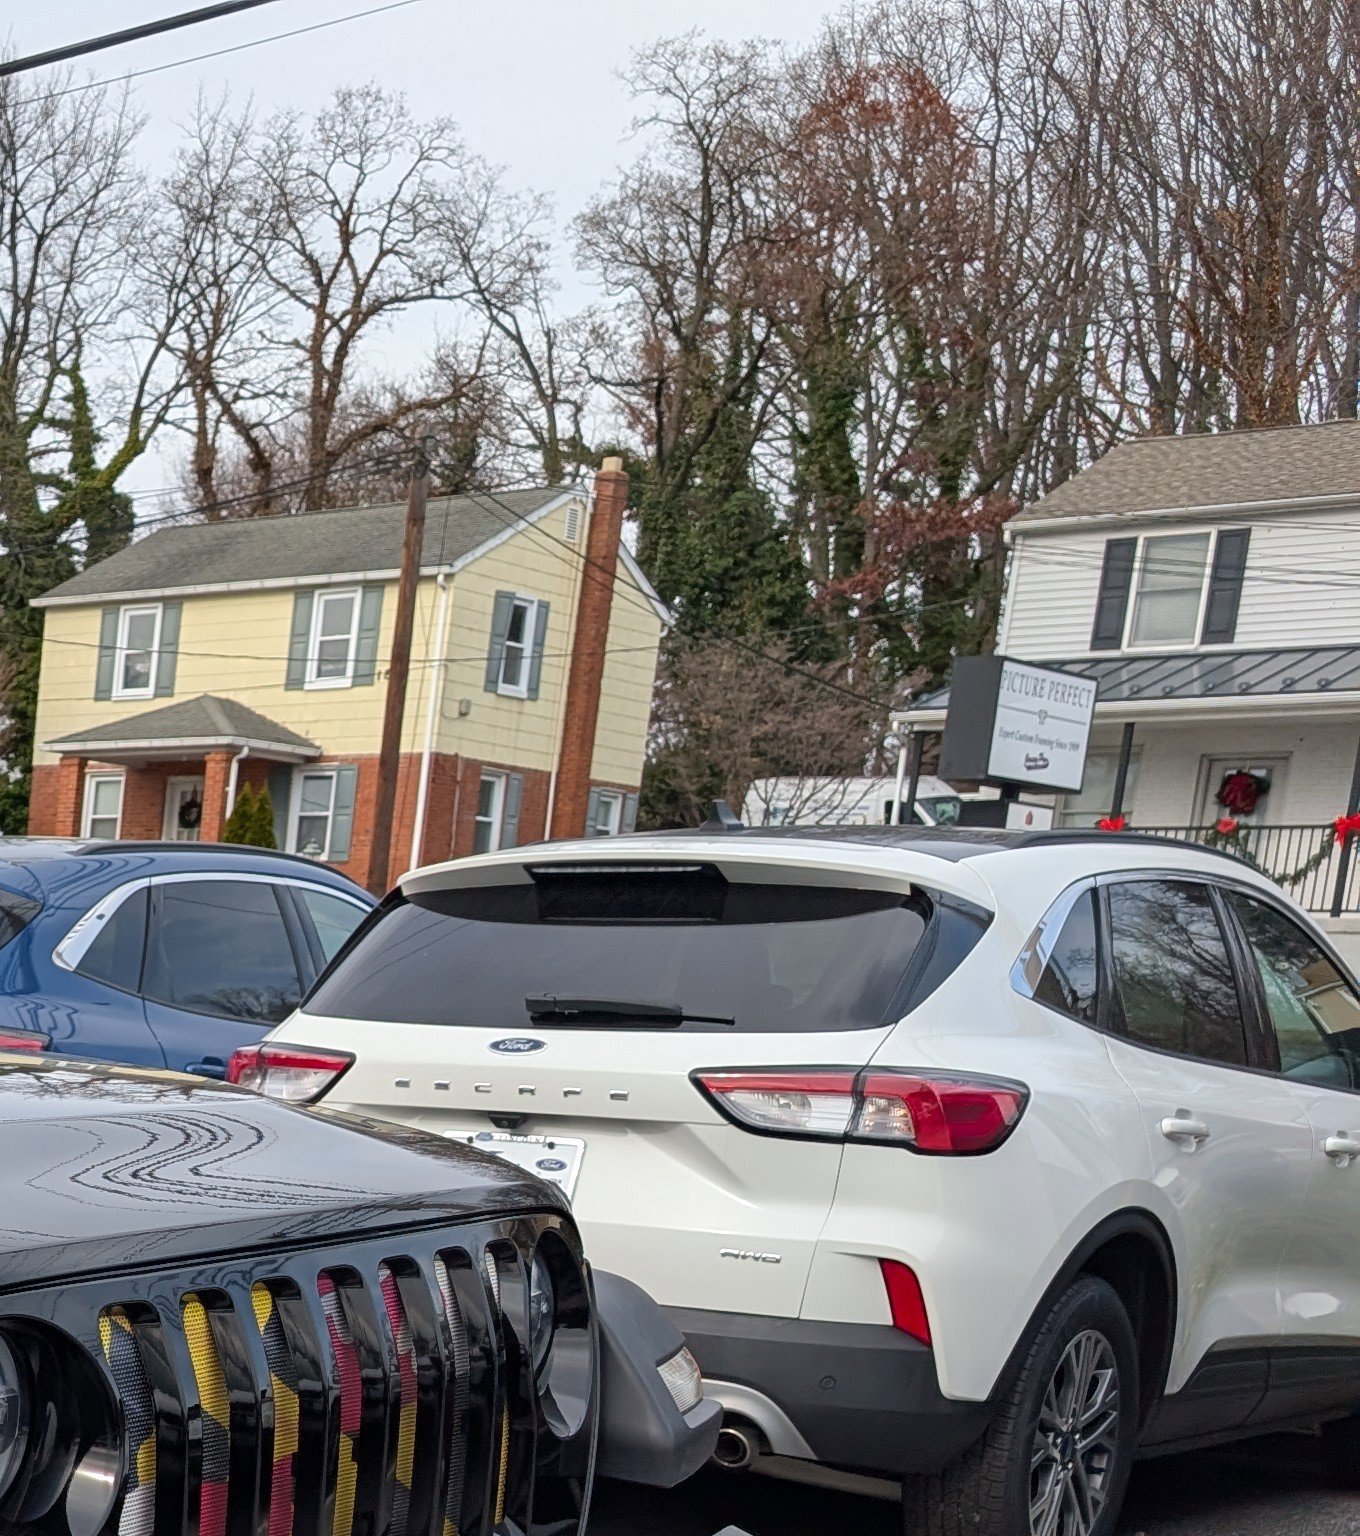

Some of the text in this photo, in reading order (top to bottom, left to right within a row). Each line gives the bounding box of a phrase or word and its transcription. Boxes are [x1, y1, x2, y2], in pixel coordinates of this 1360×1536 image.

[1000, 670, 1093, 709] PICTURE PERFECT
[498, 1038, 534, 1051] Ford
[719, 1248, 782, 1264] AWD
